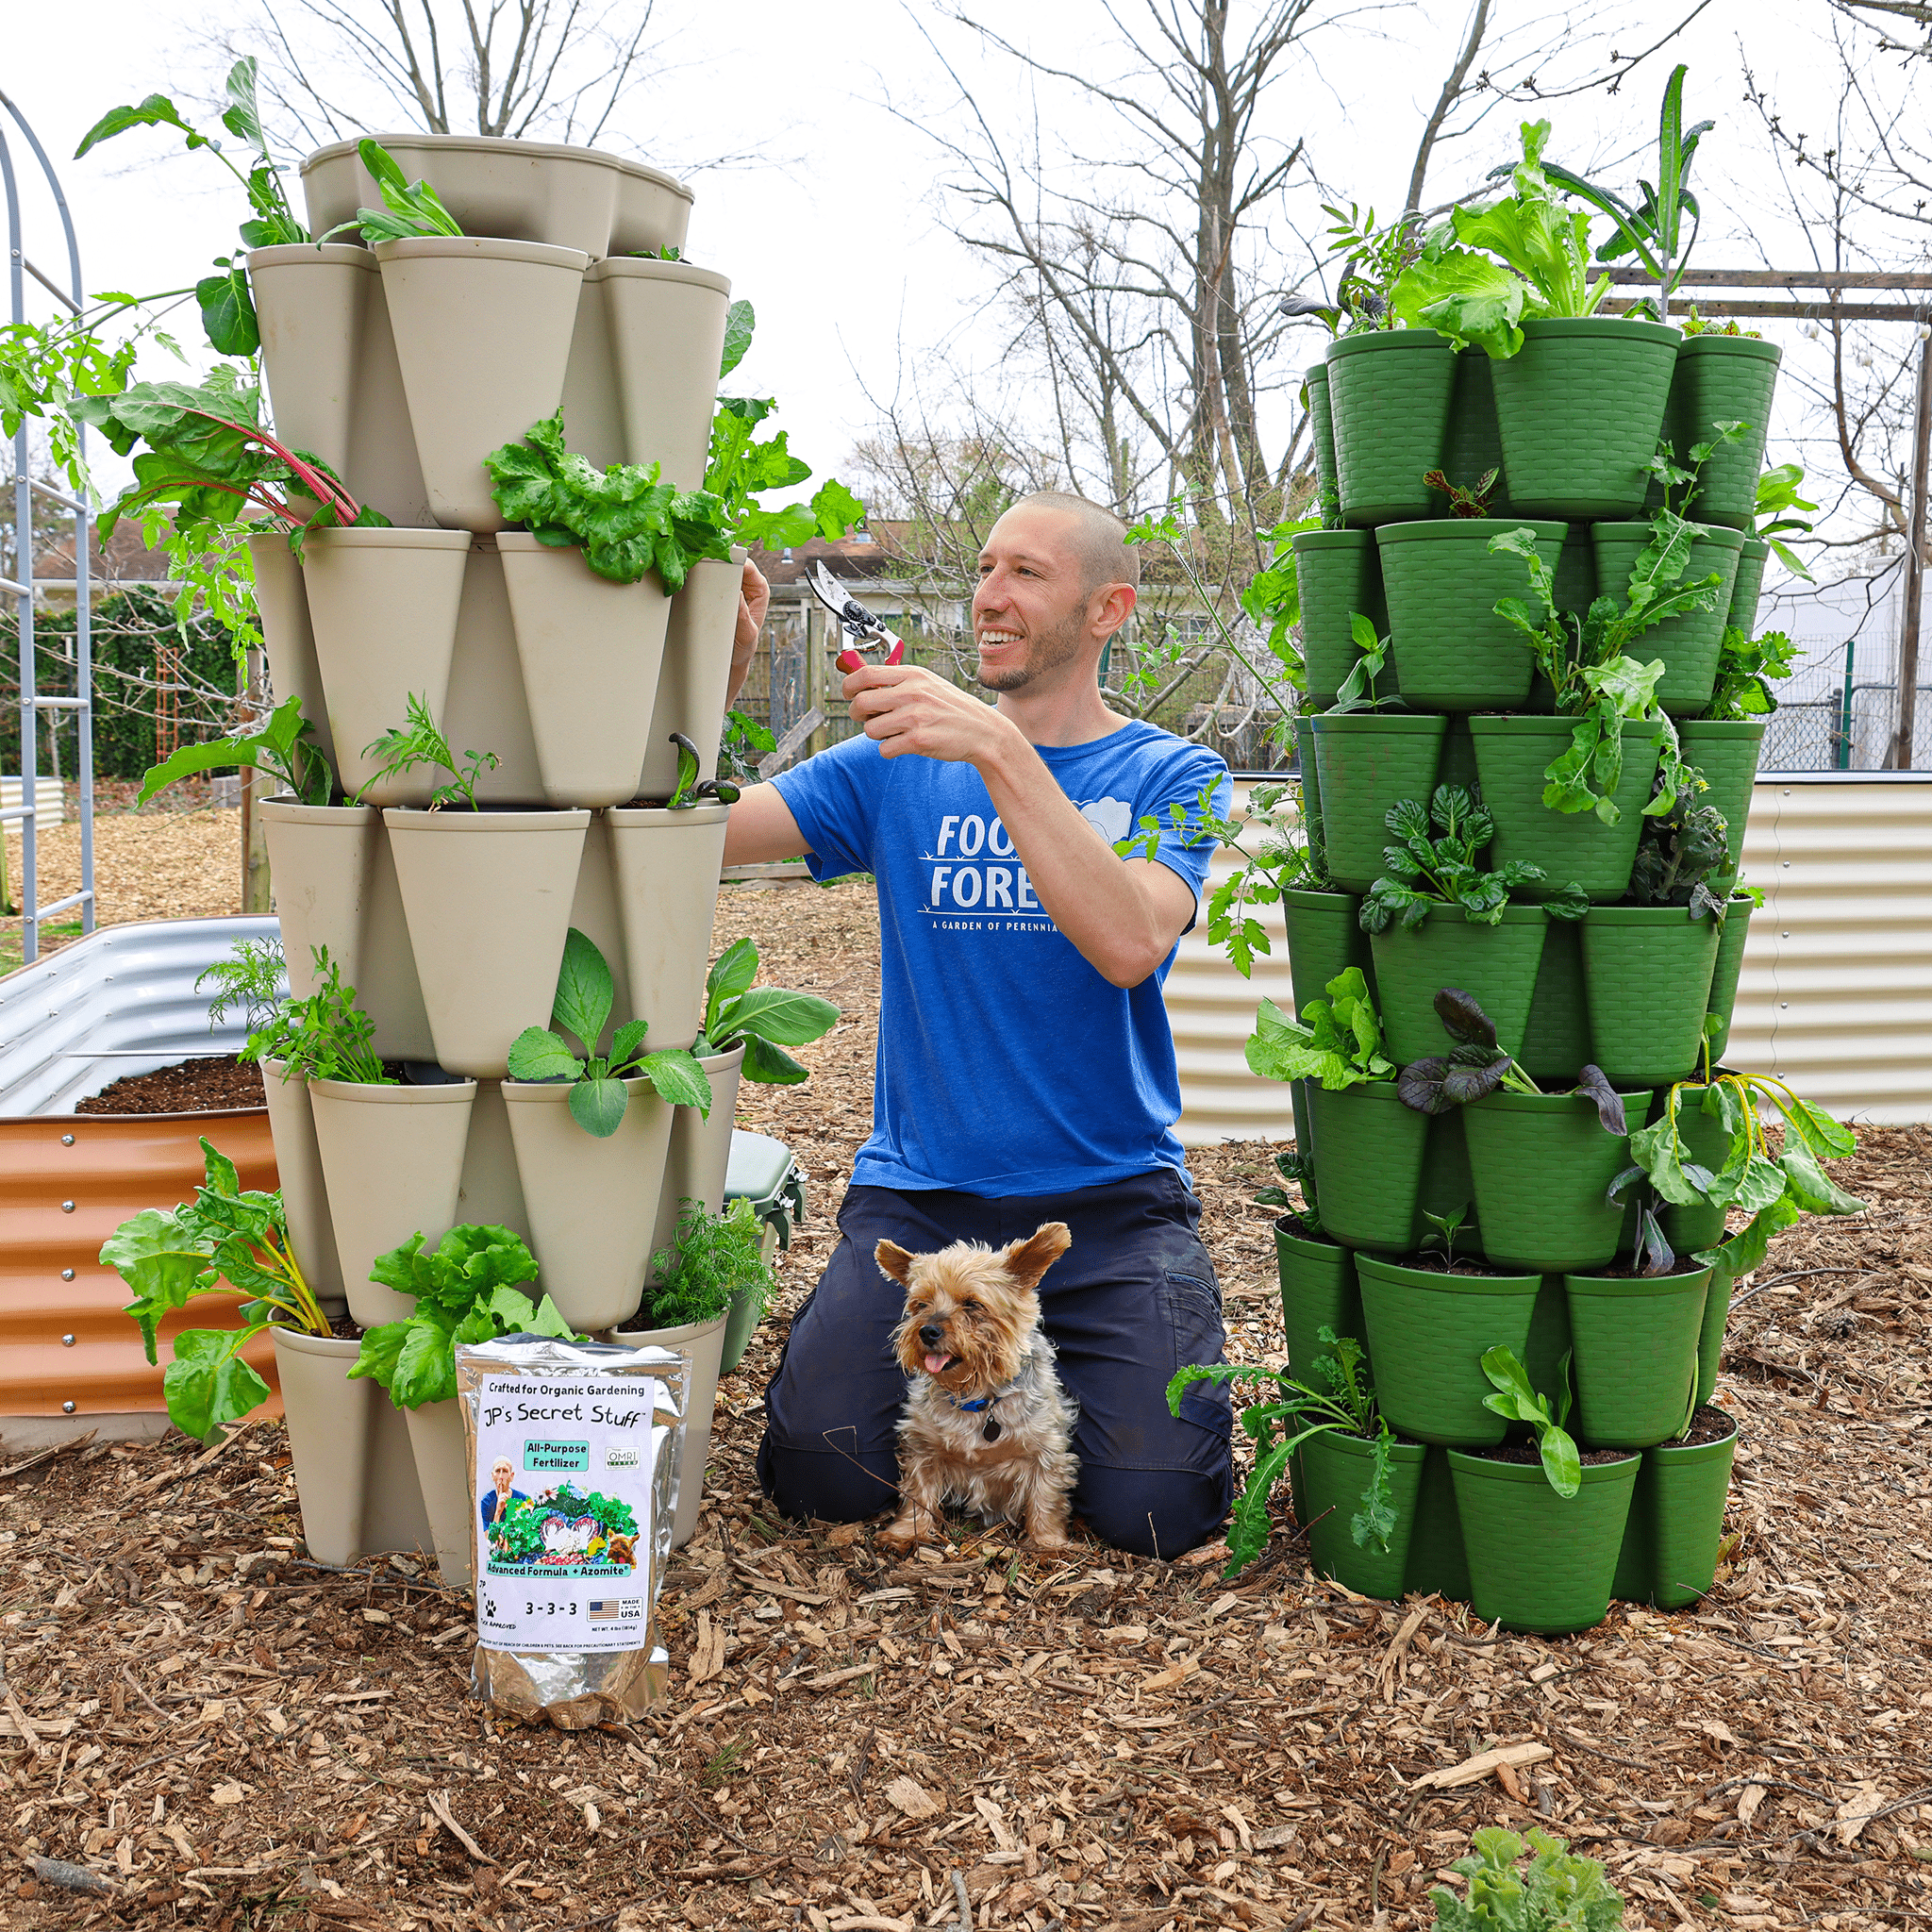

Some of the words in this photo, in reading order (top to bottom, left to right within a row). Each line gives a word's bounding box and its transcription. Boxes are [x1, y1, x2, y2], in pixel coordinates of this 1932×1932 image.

[932, 921, 938, 929] A
[941, 921, 982, 930] GARDEN
[988, 922, 1001, 931] OF
[1006, 923, 1058, 932] PERENNIA
[489, 1382, 520, 1394] Crafted
[522, 1384, 538, 1395] for
[540, 1385, 584, 1398] Organic
[587, 1385, 645, 1397] Gardening
[484, 1406, 512, 1427] JP's
[517, 1403, 583, 1422] Secret
[526, 1443, 587, 1456] All-Purpose
[533, 1457, 580, 1468] Fertilizer
[608, 1452, 637, 1461] OMRI
[487, 1563, 525, 1575] Advanced
[527, 1566, 568, 1576] Formula
[621, 1609, 641, 1619] USA
